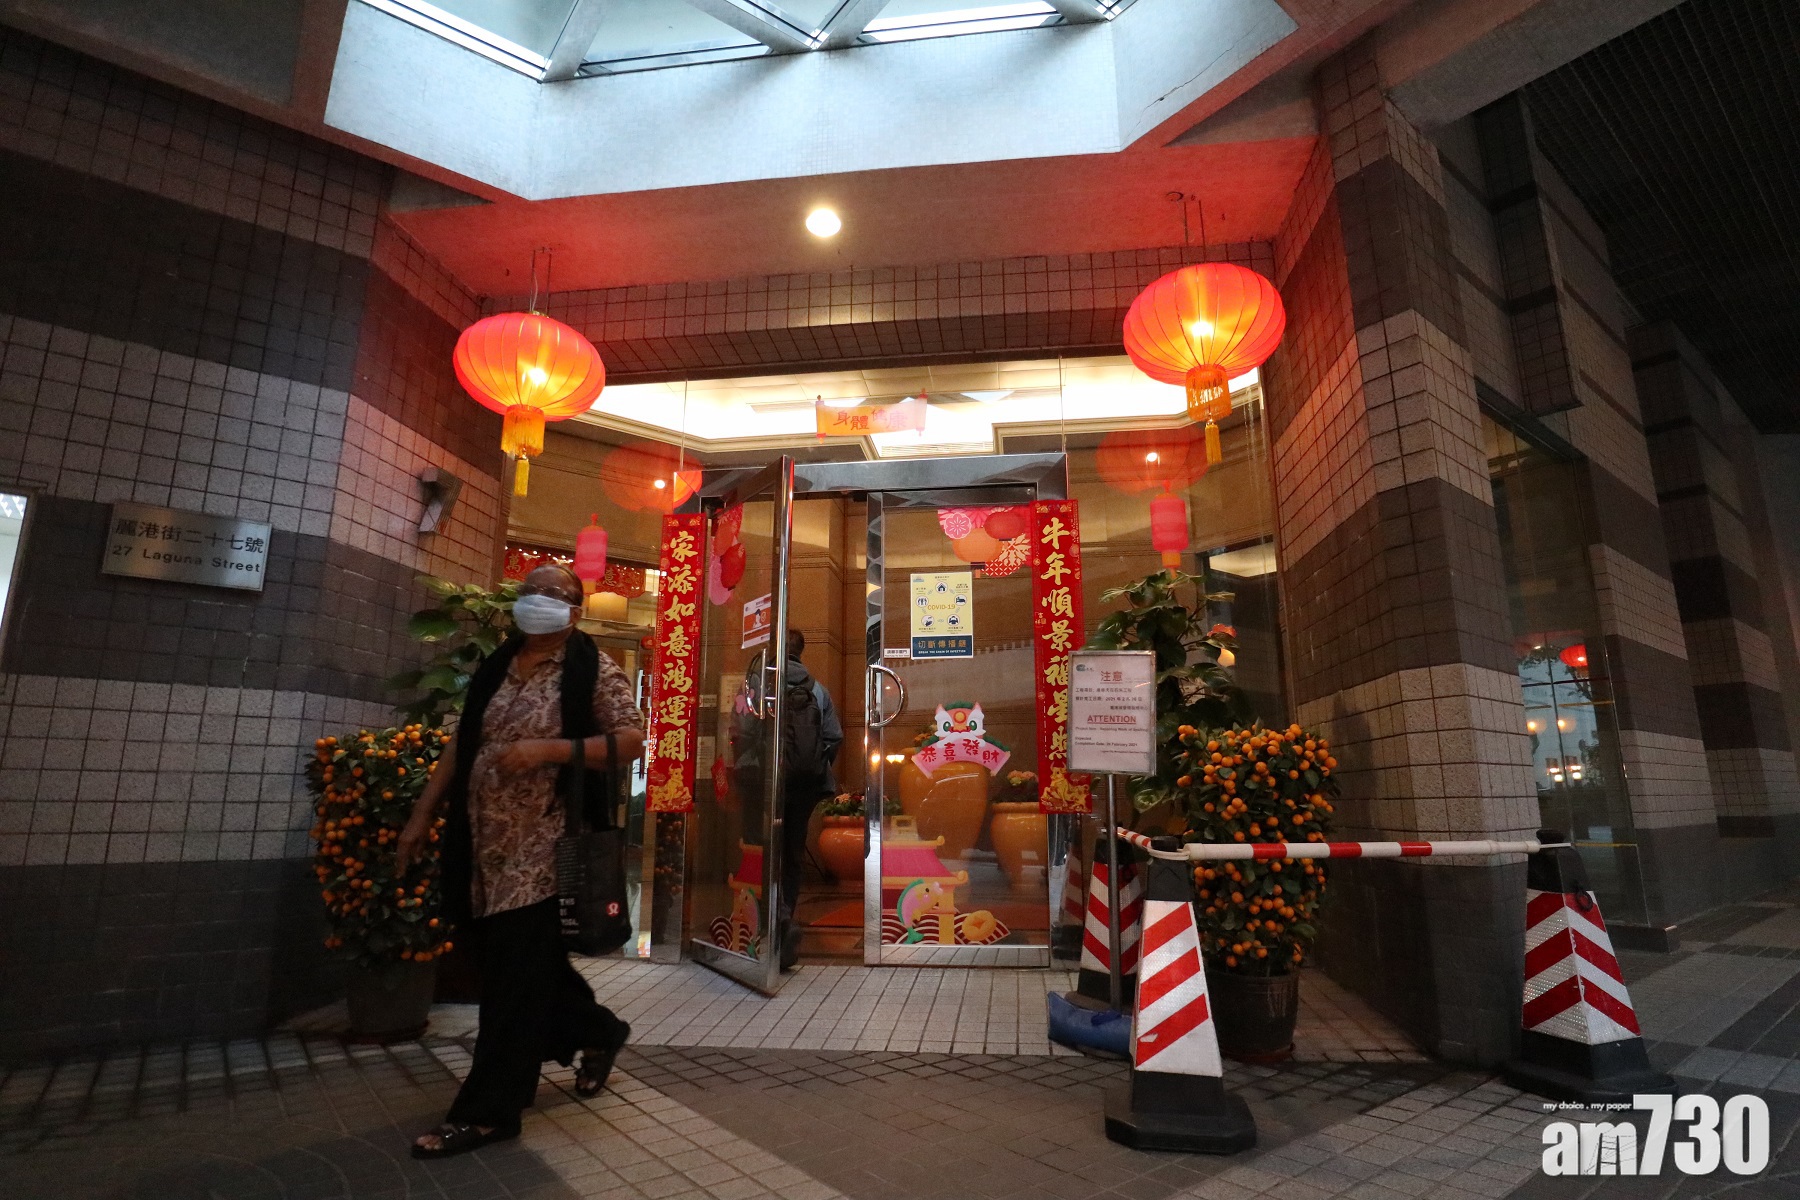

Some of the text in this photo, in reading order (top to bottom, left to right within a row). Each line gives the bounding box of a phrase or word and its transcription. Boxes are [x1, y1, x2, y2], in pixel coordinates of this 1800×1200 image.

[833, 409, 908, 431] 身體健康
[115, 518, 265, 554] 麗港街二十七號
[112, 545, 261, 573] 27 Laguna Street
[657, 530, 698, 762] 家添如意鴻運開
[1100, 671, 1123, 682] 注意
[1087, 715, 1136, 723] ATTENTION
[921, 738, 1000, 764] 恭喜發財
